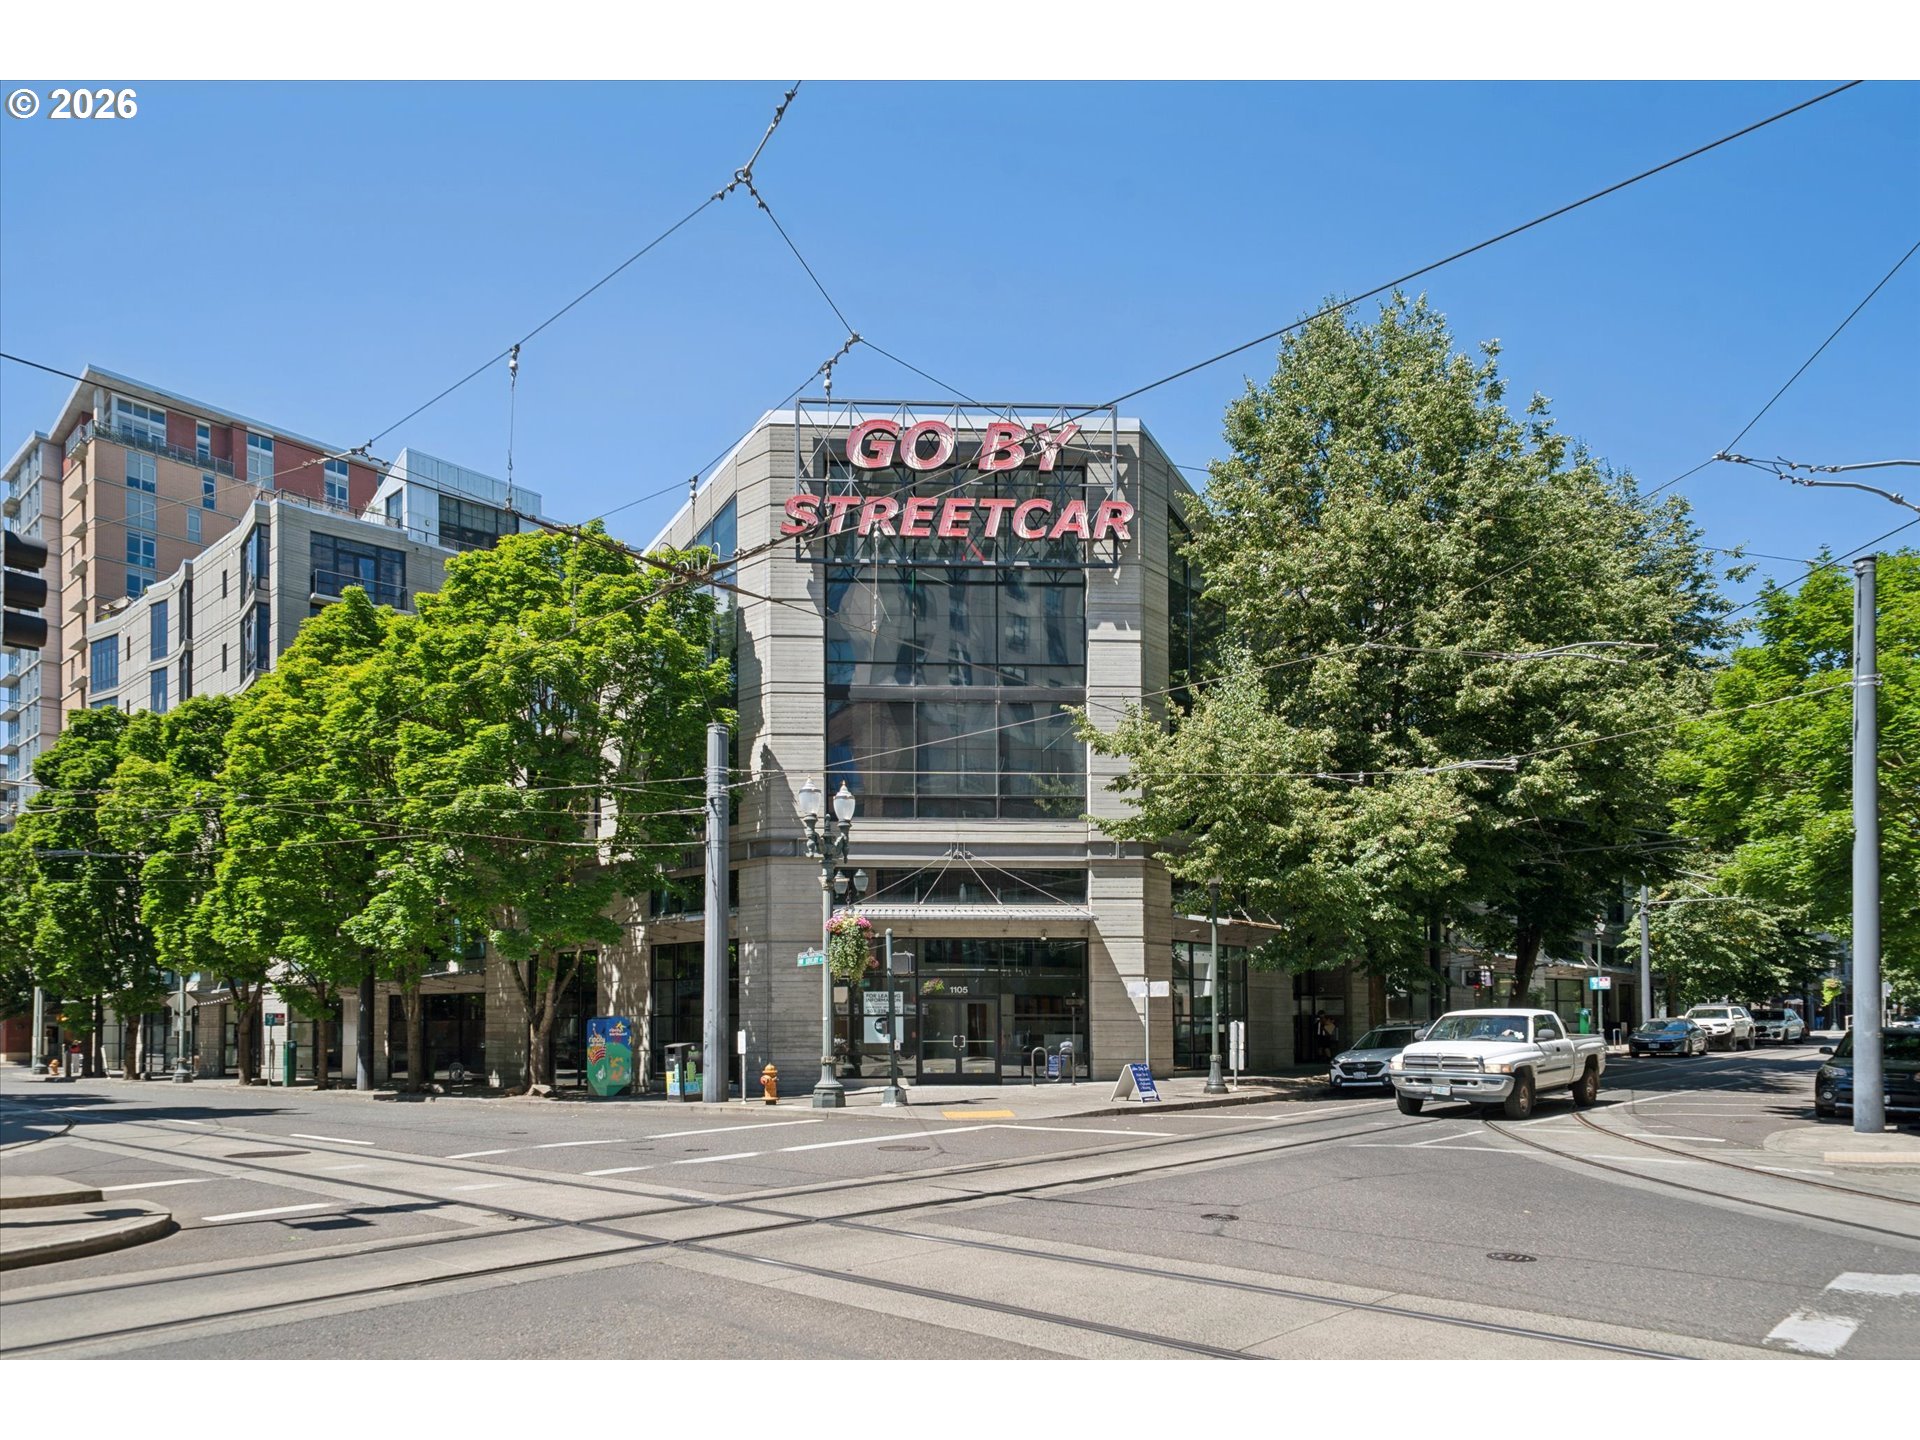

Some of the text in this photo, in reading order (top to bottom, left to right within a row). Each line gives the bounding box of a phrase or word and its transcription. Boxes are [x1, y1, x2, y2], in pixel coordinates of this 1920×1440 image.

[846, 419, 1083, 473] GO BY
[780, 495, 1134, 541] STREETCAR
[949, 985, 969, 994] 1105
